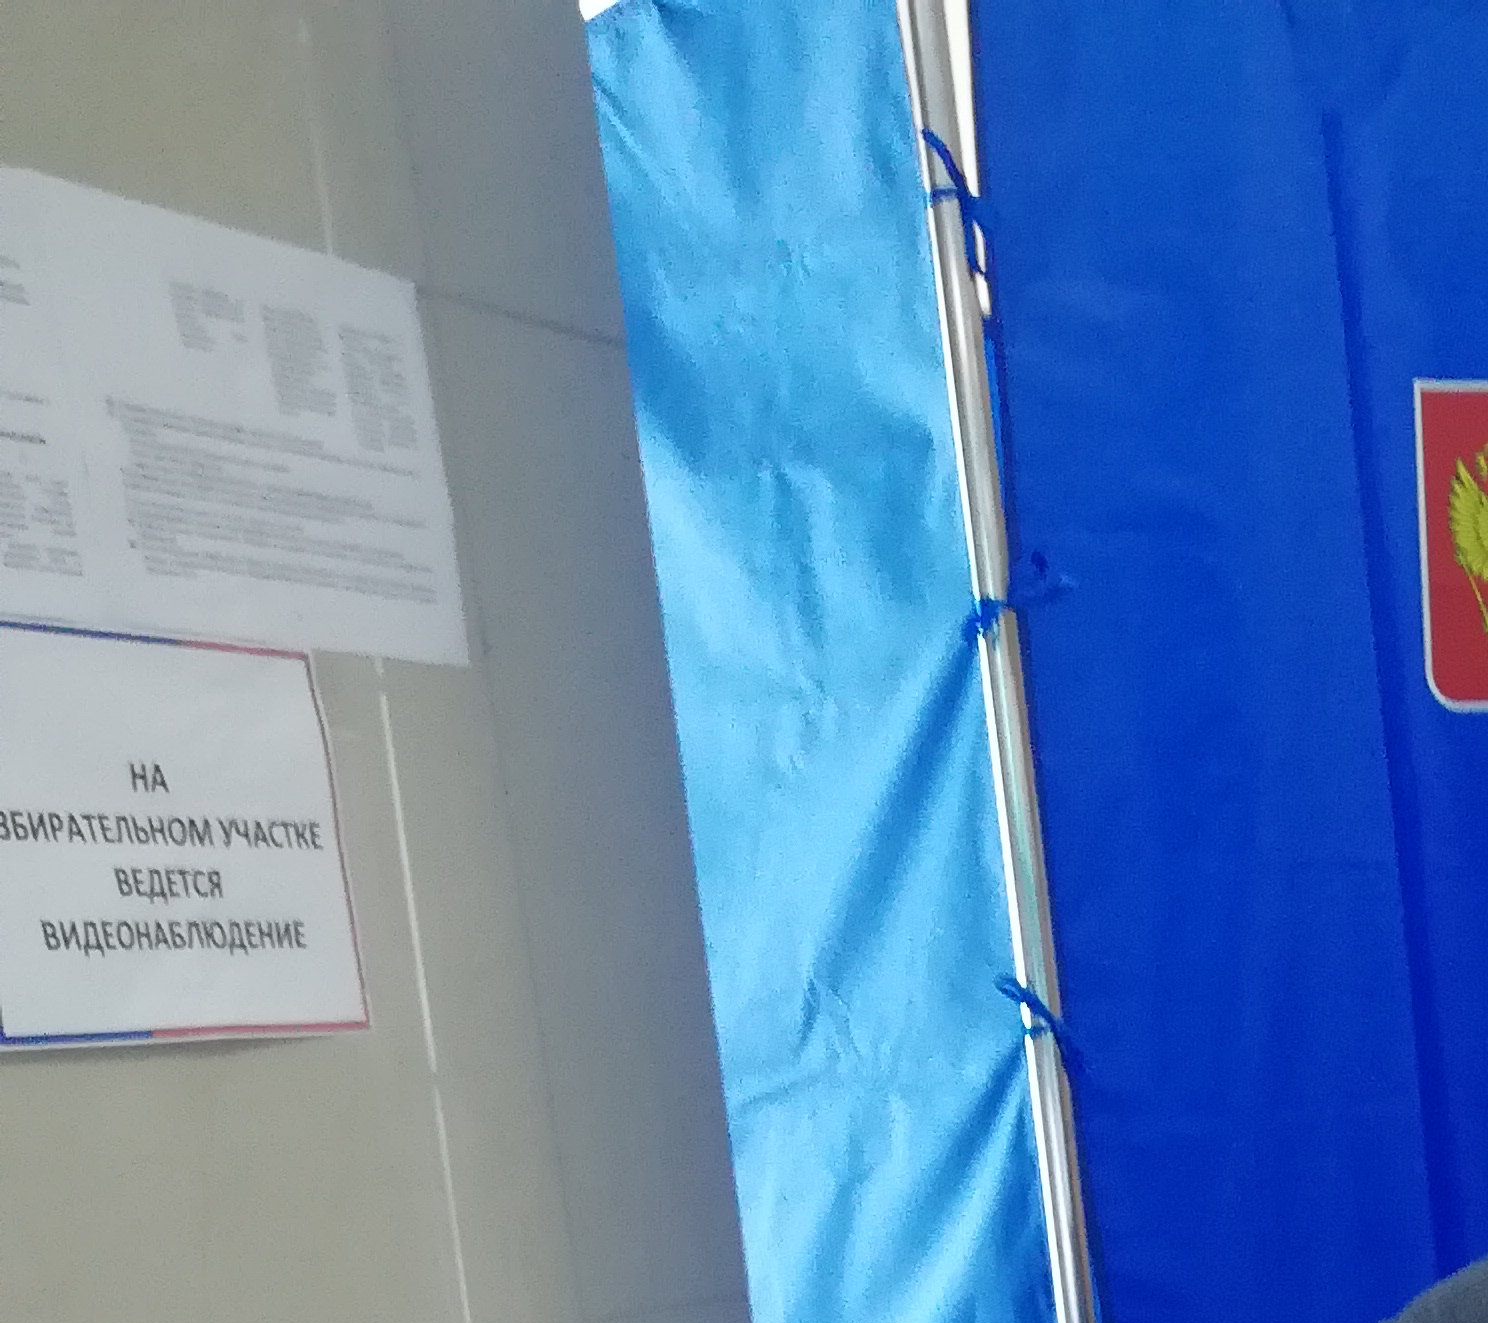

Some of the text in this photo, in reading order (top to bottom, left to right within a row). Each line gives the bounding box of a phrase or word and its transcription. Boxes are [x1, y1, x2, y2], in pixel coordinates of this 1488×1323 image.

[129, 761, 170, 793] НА
[0, 811, 324, 850] ЗБИРАТЕЛЬНОМ УЧАСТКЕ
[114, 867, 223, 904] ВЕДЕТСЯ
[40, 919, 307, 957] ВИДЕОНАБЛЮДЕНИЕ
